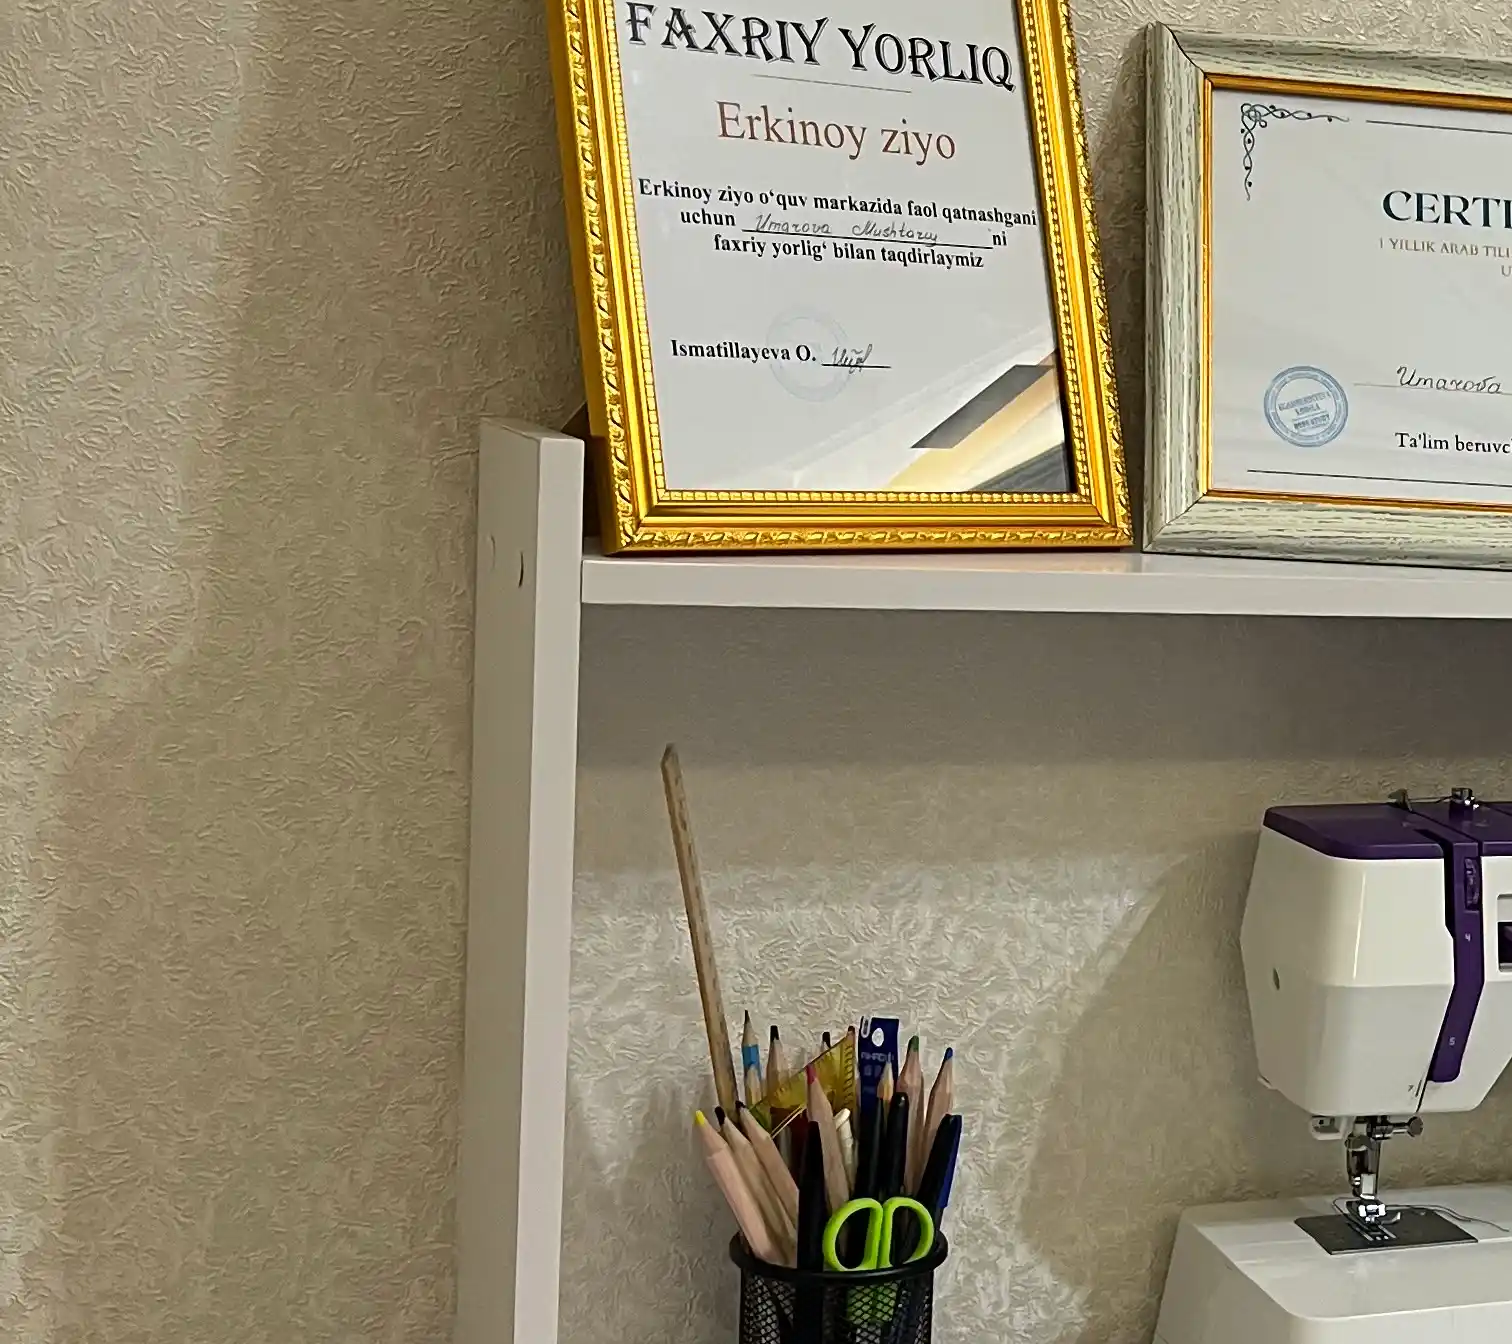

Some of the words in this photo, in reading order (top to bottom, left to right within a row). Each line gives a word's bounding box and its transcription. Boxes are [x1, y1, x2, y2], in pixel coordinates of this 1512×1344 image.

[626, 1, 829, 66] FAXRIY
[838, 23, 1016, 92] YORLIQ
[717, 101, 867, 160] Erkinoy
[881, 119, 956, 166] ziyo
[638, 178, 712, 204] Erkinoy
[718, 186, 754, 206] ziyo
[813, 195, 903, 216] markazida
[907, 200, 938, 218] faol
[942, 207, 1037, 227] qatnashgani
[680, 208, 736, 226] uchun
[992, 231, 1007, 246] ni
[714, 234, 766, 257] faxriy
[833, 242, 876, 260] bilan
[881, 247, 984, 269] taqdirlaymiz
[1388, 238, 1435, 253] YILLIK
[1440, 242, 1479, 256] ARAB
[1484, 245, 1510, 258] TILI
[671, 339, 790, 363] Ismatillayeva
[796, 344, 816, 362] O.
[1397, 366, 1501, 395] Umarova
[1395, 432, 1449, 452] Ta'lim
